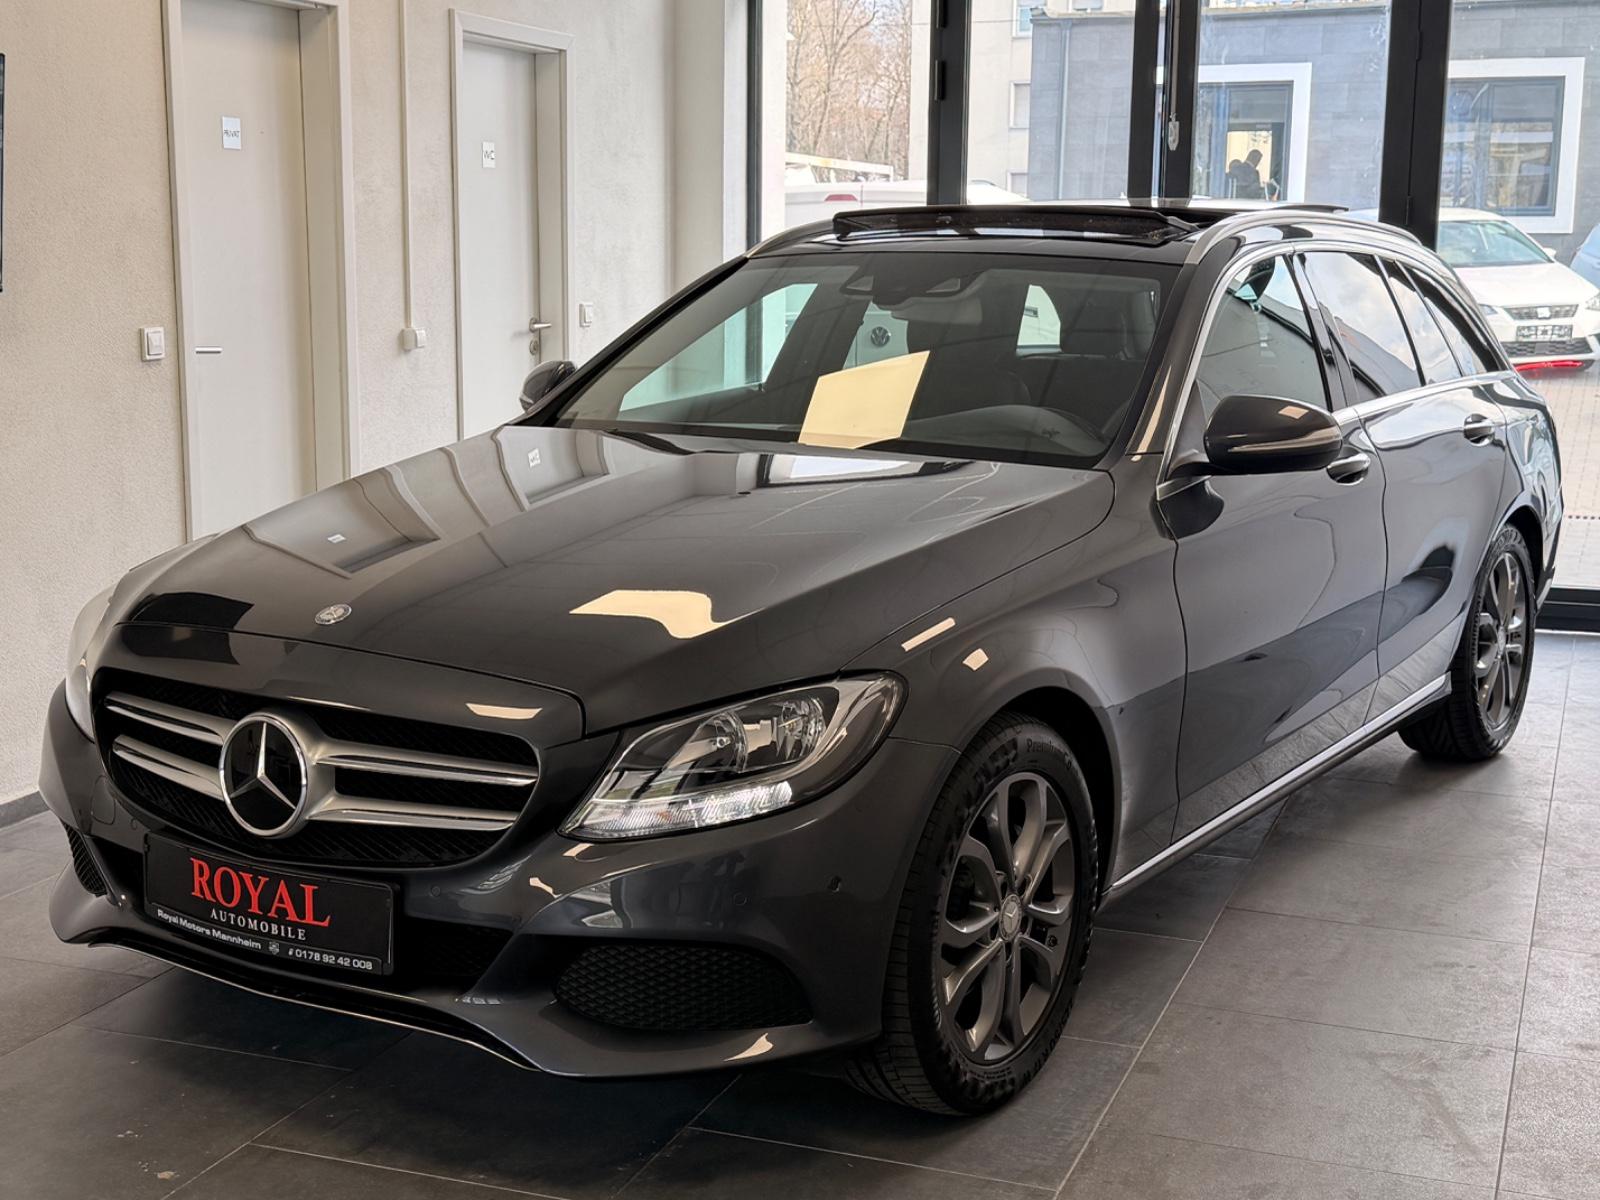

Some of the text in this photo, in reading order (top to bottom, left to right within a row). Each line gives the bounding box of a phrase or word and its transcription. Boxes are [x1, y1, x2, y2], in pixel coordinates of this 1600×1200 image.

[190, 857, 331, 927] ROYAL
[157, 908, 373, 970] Royal Motors Mannheim 0178 92 42 008
[210, 908, 306, 940] AUTOMOBILE
